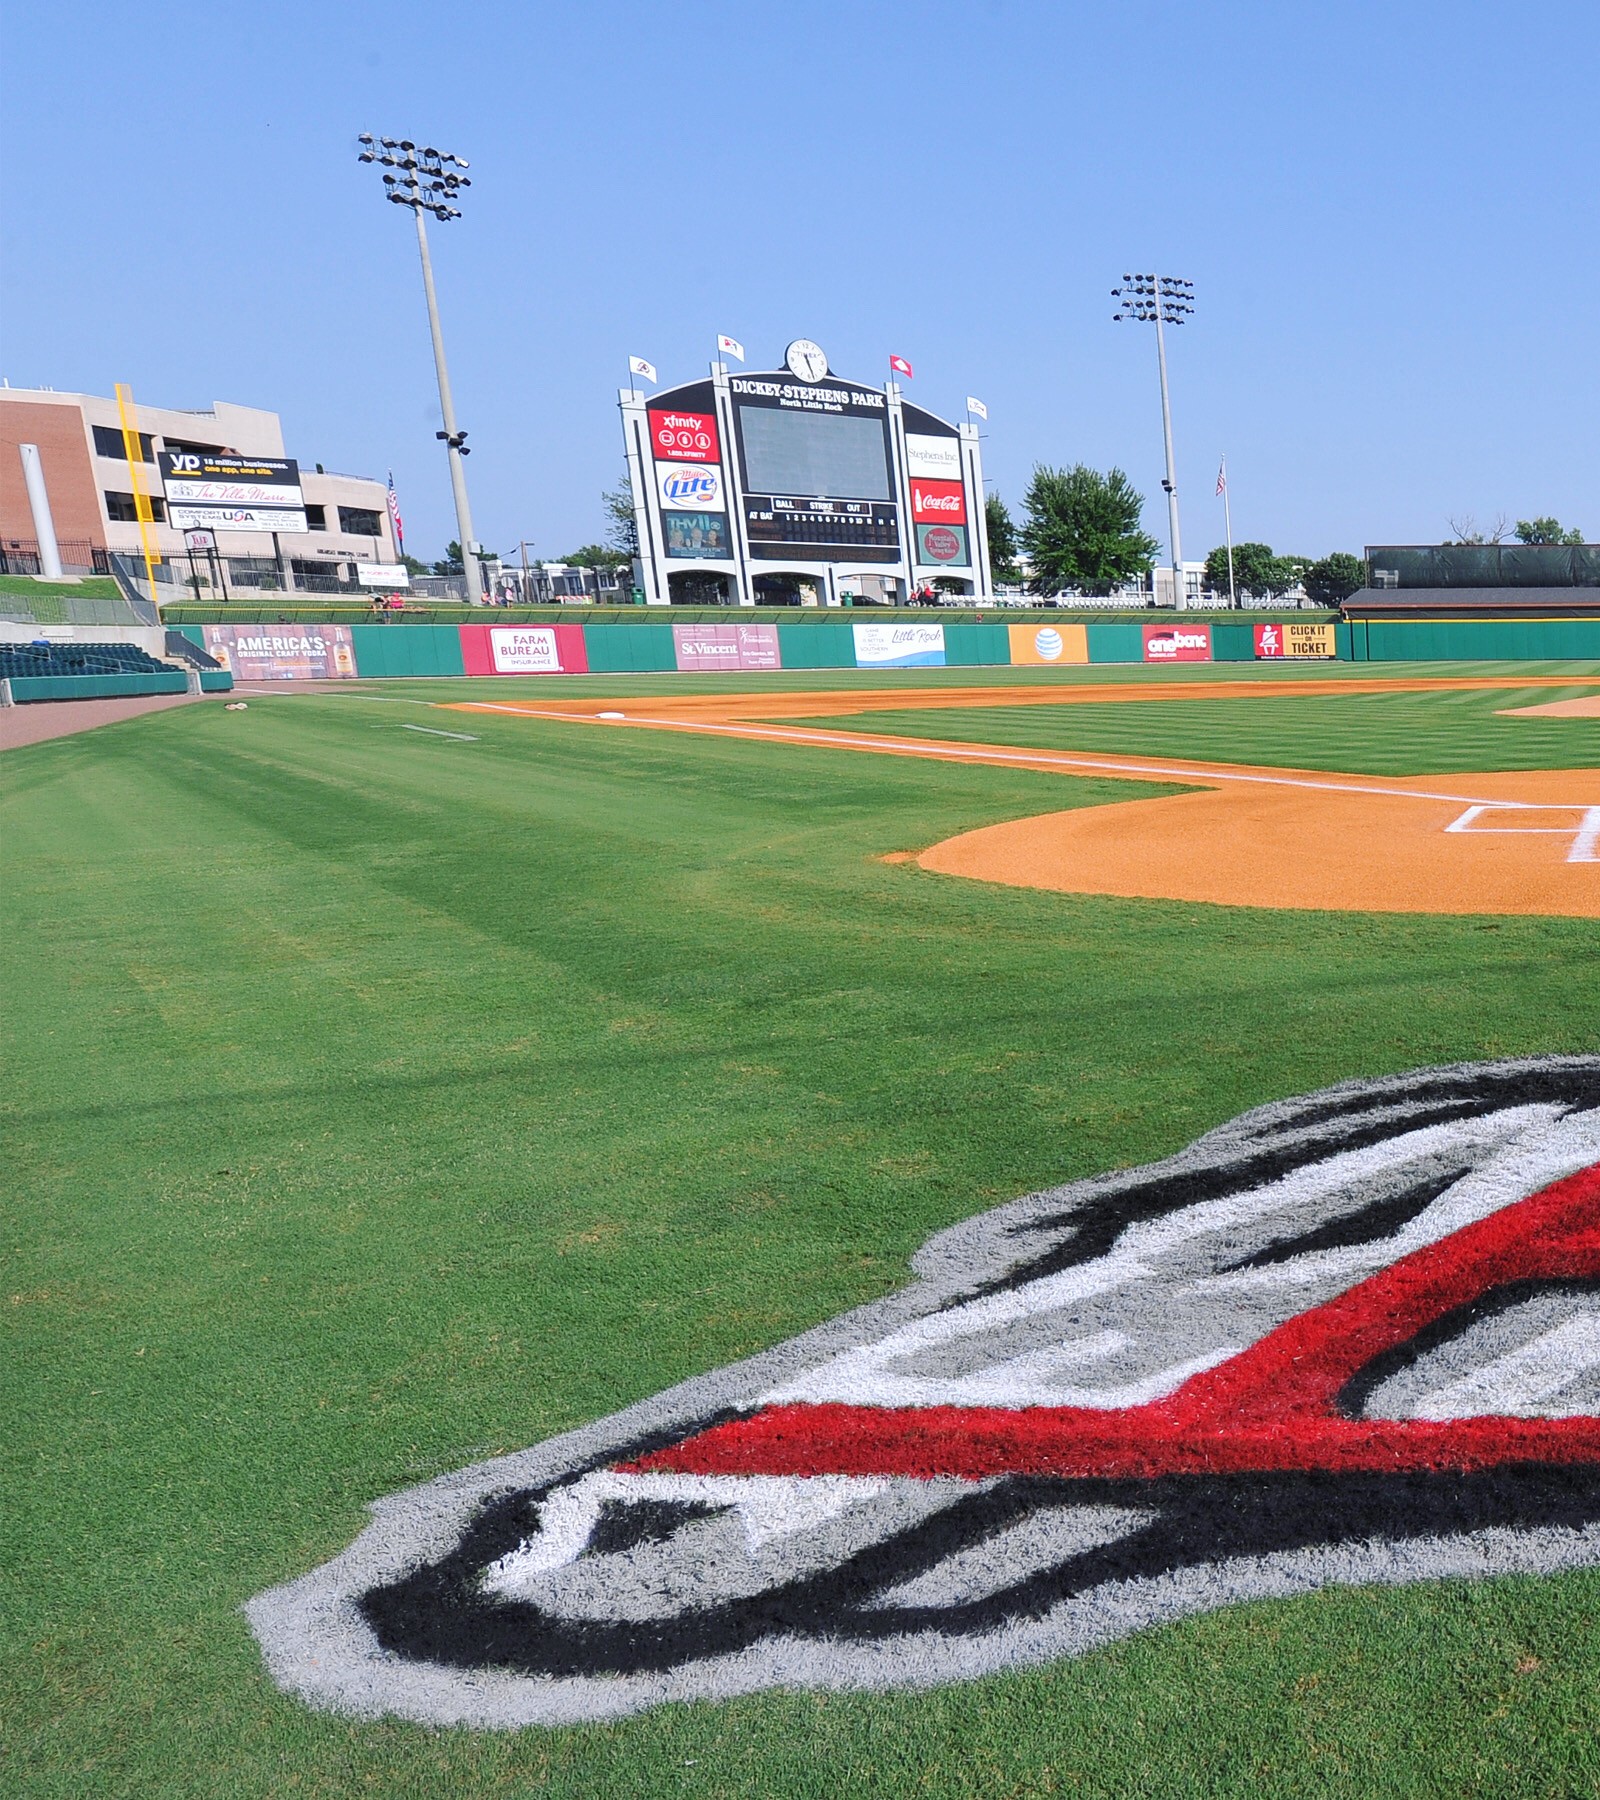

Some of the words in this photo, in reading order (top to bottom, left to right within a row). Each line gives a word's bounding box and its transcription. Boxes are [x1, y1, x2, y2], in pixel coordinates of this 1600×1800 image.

[732, 379, 850, 404] DICKEY-STEPHENS
[851, 392, 885, 408] PARK
[780, 398, 801, 407] North
[803, 400, 823, 410] Little
[824, 403, 842, 411] Rock
[663, 414, 702, 431] xfinity
[909, 448, 943, 461] Stephens
[944, 451, 958, 462] Inc.
[169, 454, 199, 471] yp
[215, 459, 242, 467] million
[244, 461, 288, 469] businesses.
[222, 467, 239, 475] app,
[678, 470, 706, 480] Miller
[191, 484, 216, 498] The
[216, 485, 246, 499] Villa
[669, 478, 715, 498] Lite
[776, 500, 794, 508] BALL
[810, 502, 834, 511] STRIKE
[847, 504, 860, 512] OUT
[223, 510, 255, 522] USA
[667, 518, 697, 528] THV
[892, 629, 915, 643] Little
[917, 629, 940, 643] Rock
[1291, 626, 1315, 635] CLICK
[1318, 626, 1325, 634] IT
[237, 637, 324, 651] AMERICA'S
[514, 636, 547, 644] FARM
[501, 646, 549, 655] BUREAU
[682, 643, 695, 654] St.
[694, 642, 737, 654] Vincent
[1292, 643, 1327, 653] TICKET
